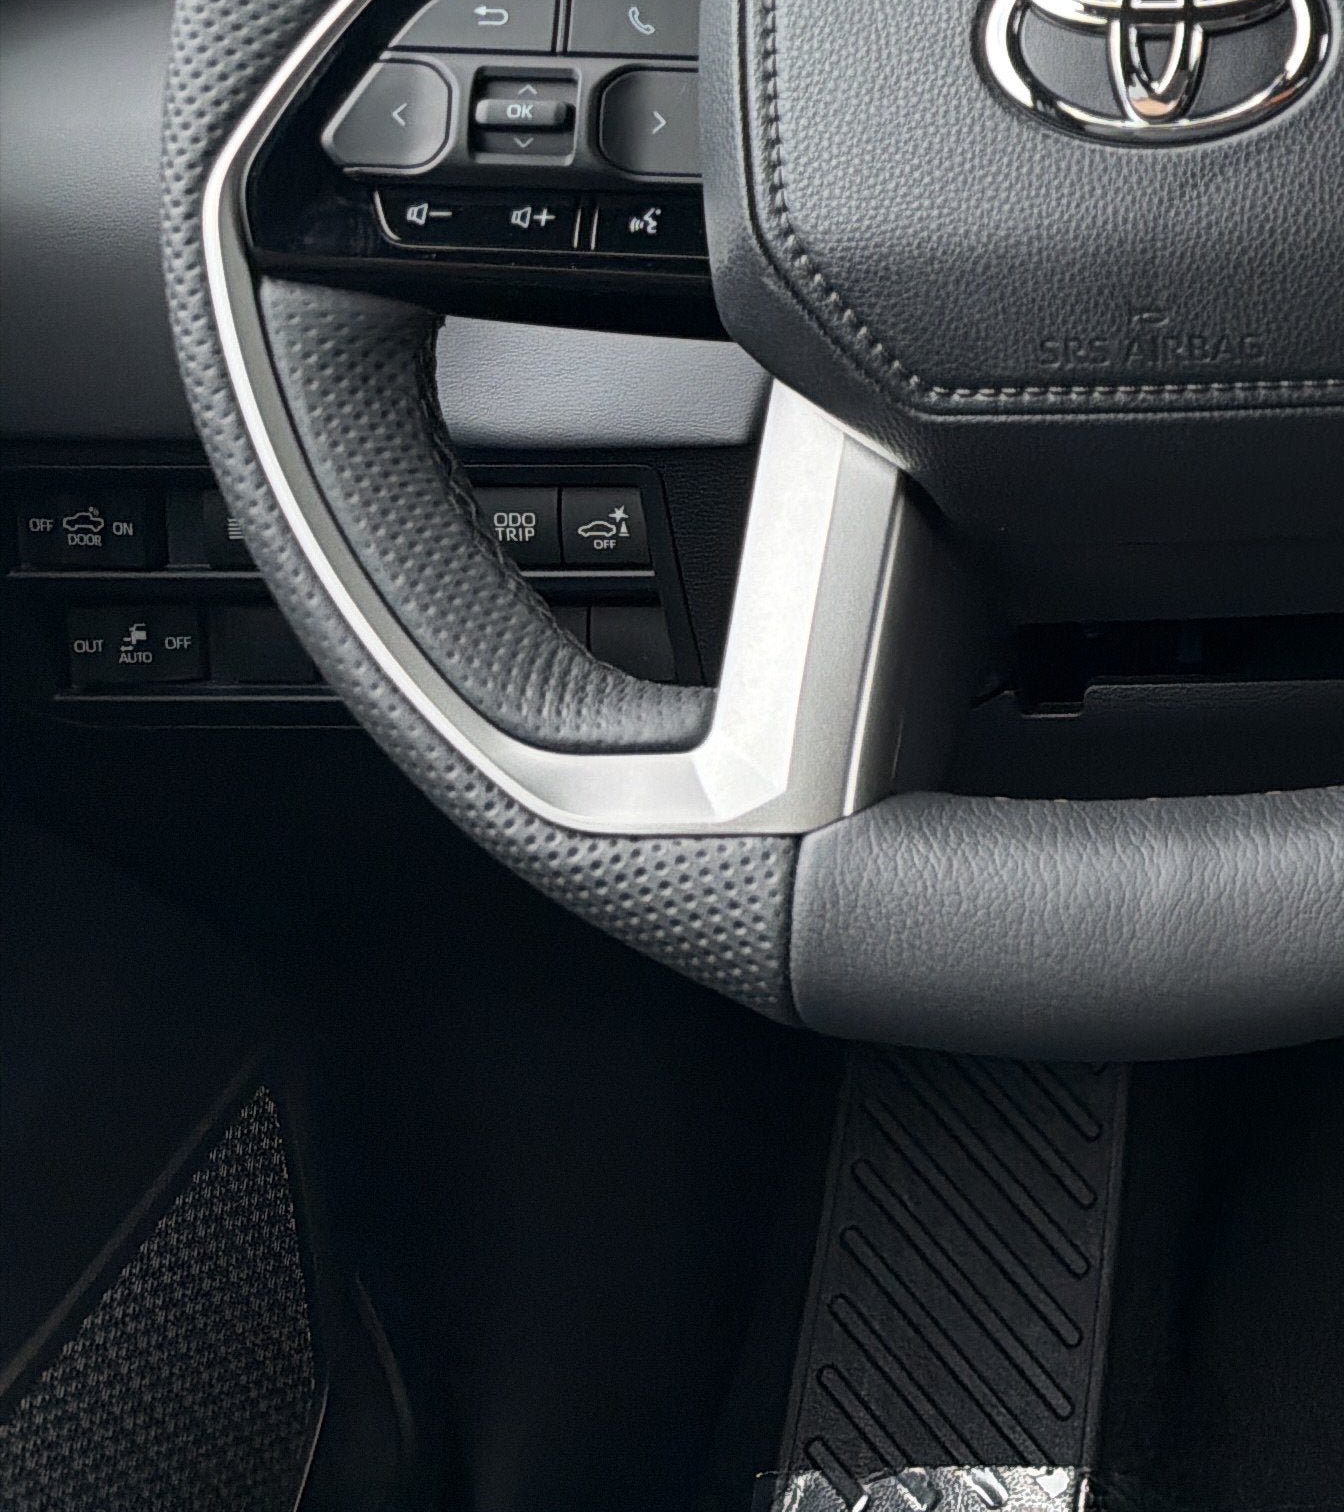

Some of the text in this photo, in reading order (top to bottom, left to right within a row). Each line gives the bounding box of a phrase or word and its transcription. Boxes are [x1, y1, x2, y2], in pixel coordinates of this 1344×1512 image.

[506, 103, 534, 120] OK
[1038, 334, 1266, 367] SRS AIRBAG
[28, 518, 134, 538] OFF ON
[493, 512, 536, 528] ODO
[67, 533, 103, 547] DOOR
[495, 527, 535, 543] TRIP
[593, 539, 617, 550] OFF
[73, 639, 104, 655] OUT
[164, 635, 192, 650] OFF
[118, 651, 153, 665] AUTO
